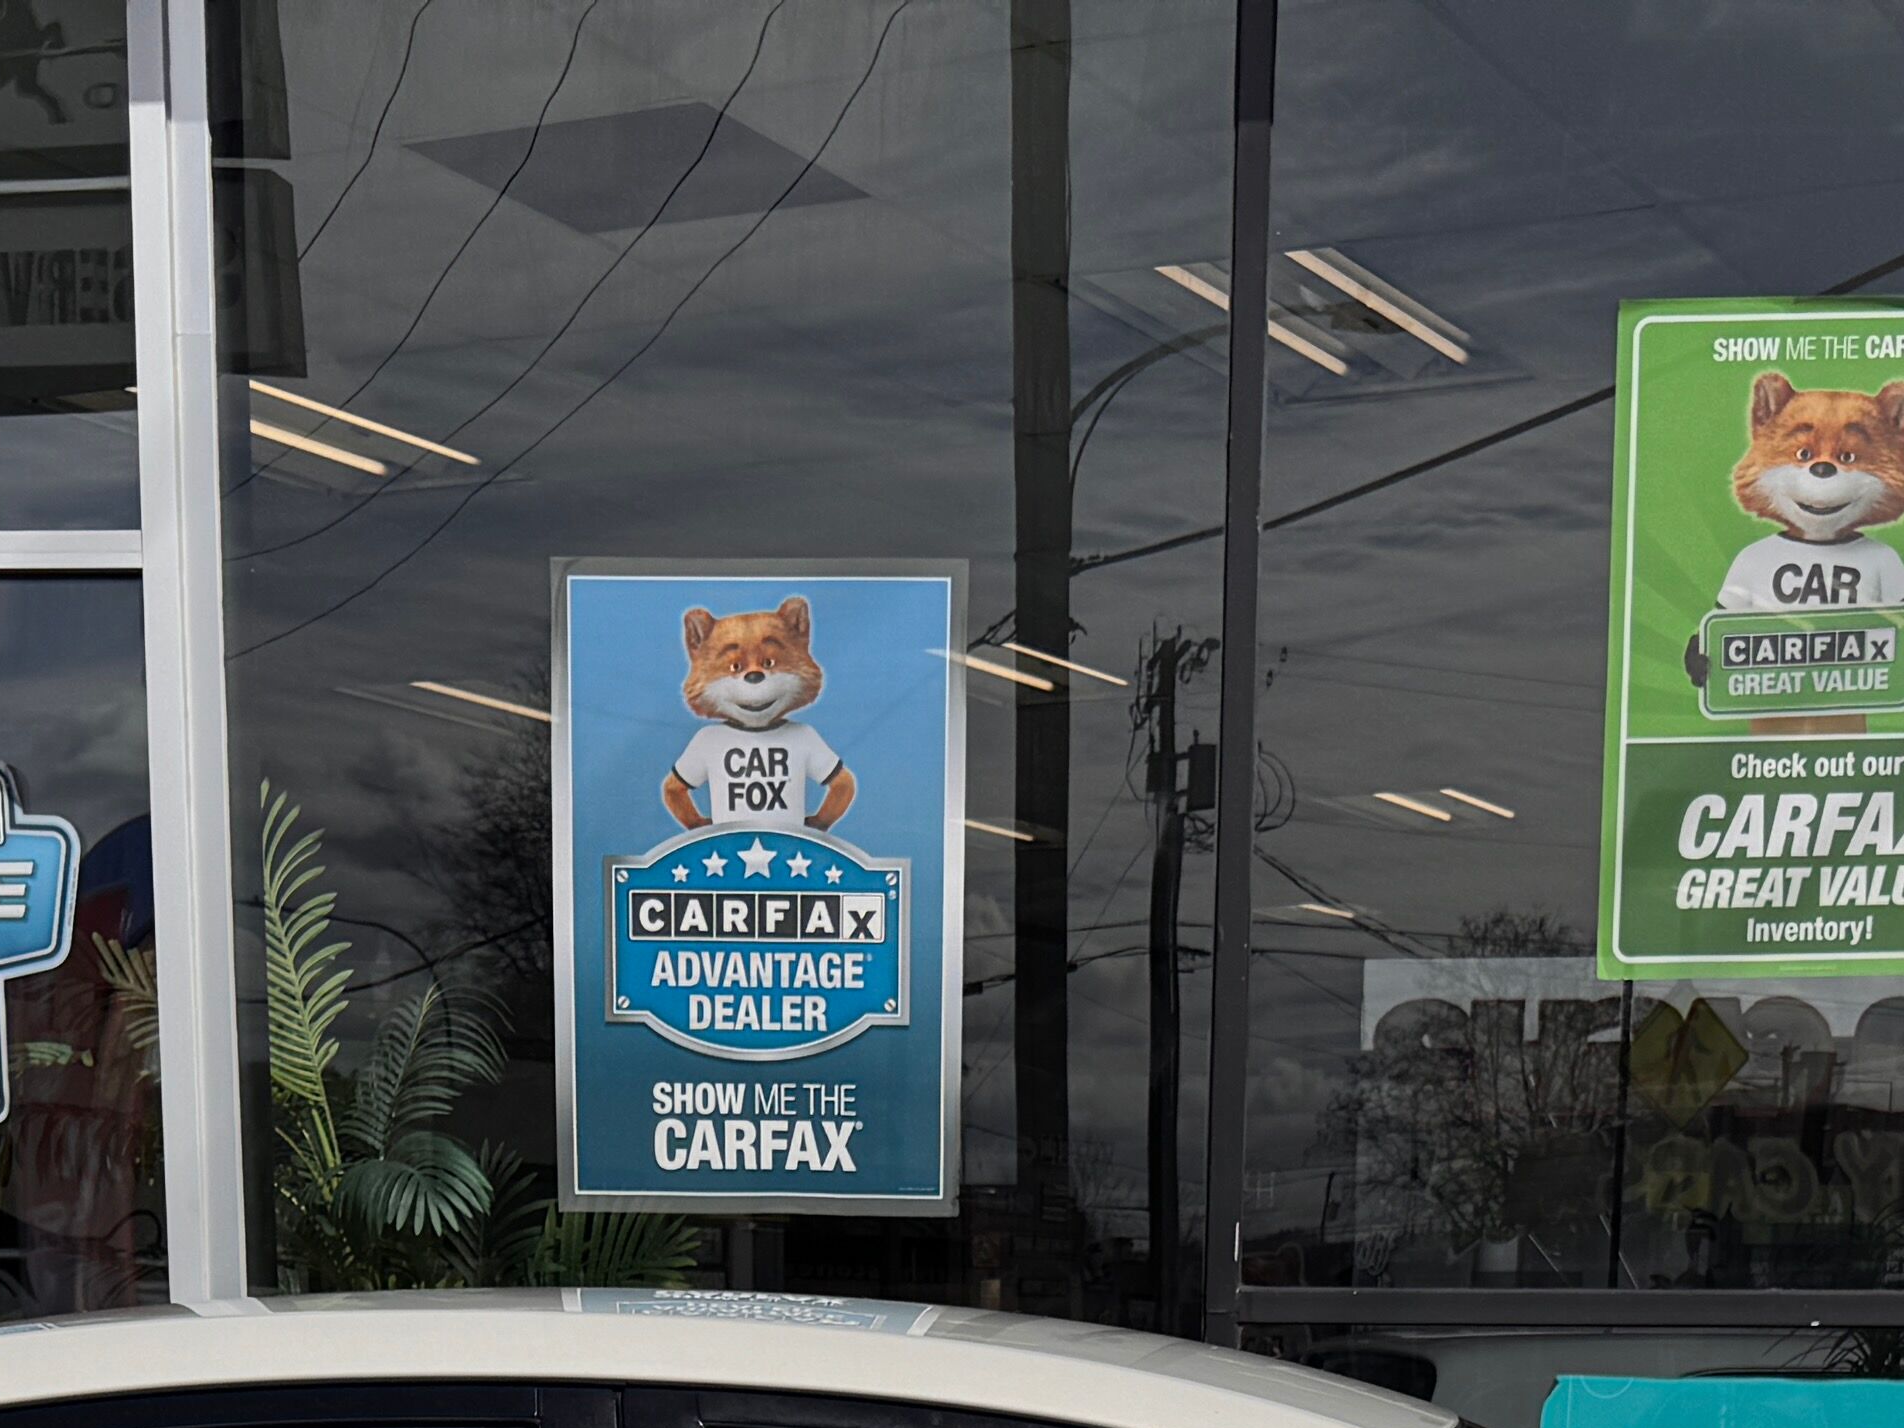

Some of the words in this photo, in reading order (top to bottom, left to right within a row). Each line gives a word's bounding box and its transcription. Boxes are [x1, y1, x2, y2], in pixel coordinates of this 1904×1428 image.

[1713, 337, 1780, 362] SHOW
[1786, 337, 1817, 361] ME
[1821, 336, 1860, 360] THE
[1772, 563, 1861, 604] CAR
[1728, 634, 1889, 663] CARFAX
[1728, 672, 1805, 696] GREAT
[1812, 668, 1889, 693] VALUE
[724, 748, 789, 778] CAR
[1731, 752, 1808, 779] Check
[1814, 751, 1856, 778] out
[728, 781, 788, 811] FOX
[1675, 866, 1812, 910] GREAT
[638, 899, 877, 939] CARFAX
[1746, 915, 1873, 945] Inventory!
[689, 995, 828, 1032] DEALER
[652, 1082, 746, 1115] SHOW
[755, 1083, 796, 1116] ME
[803, 1084, 856, 1116] THE
[654, 1118, 857, 1173] CARFAX
